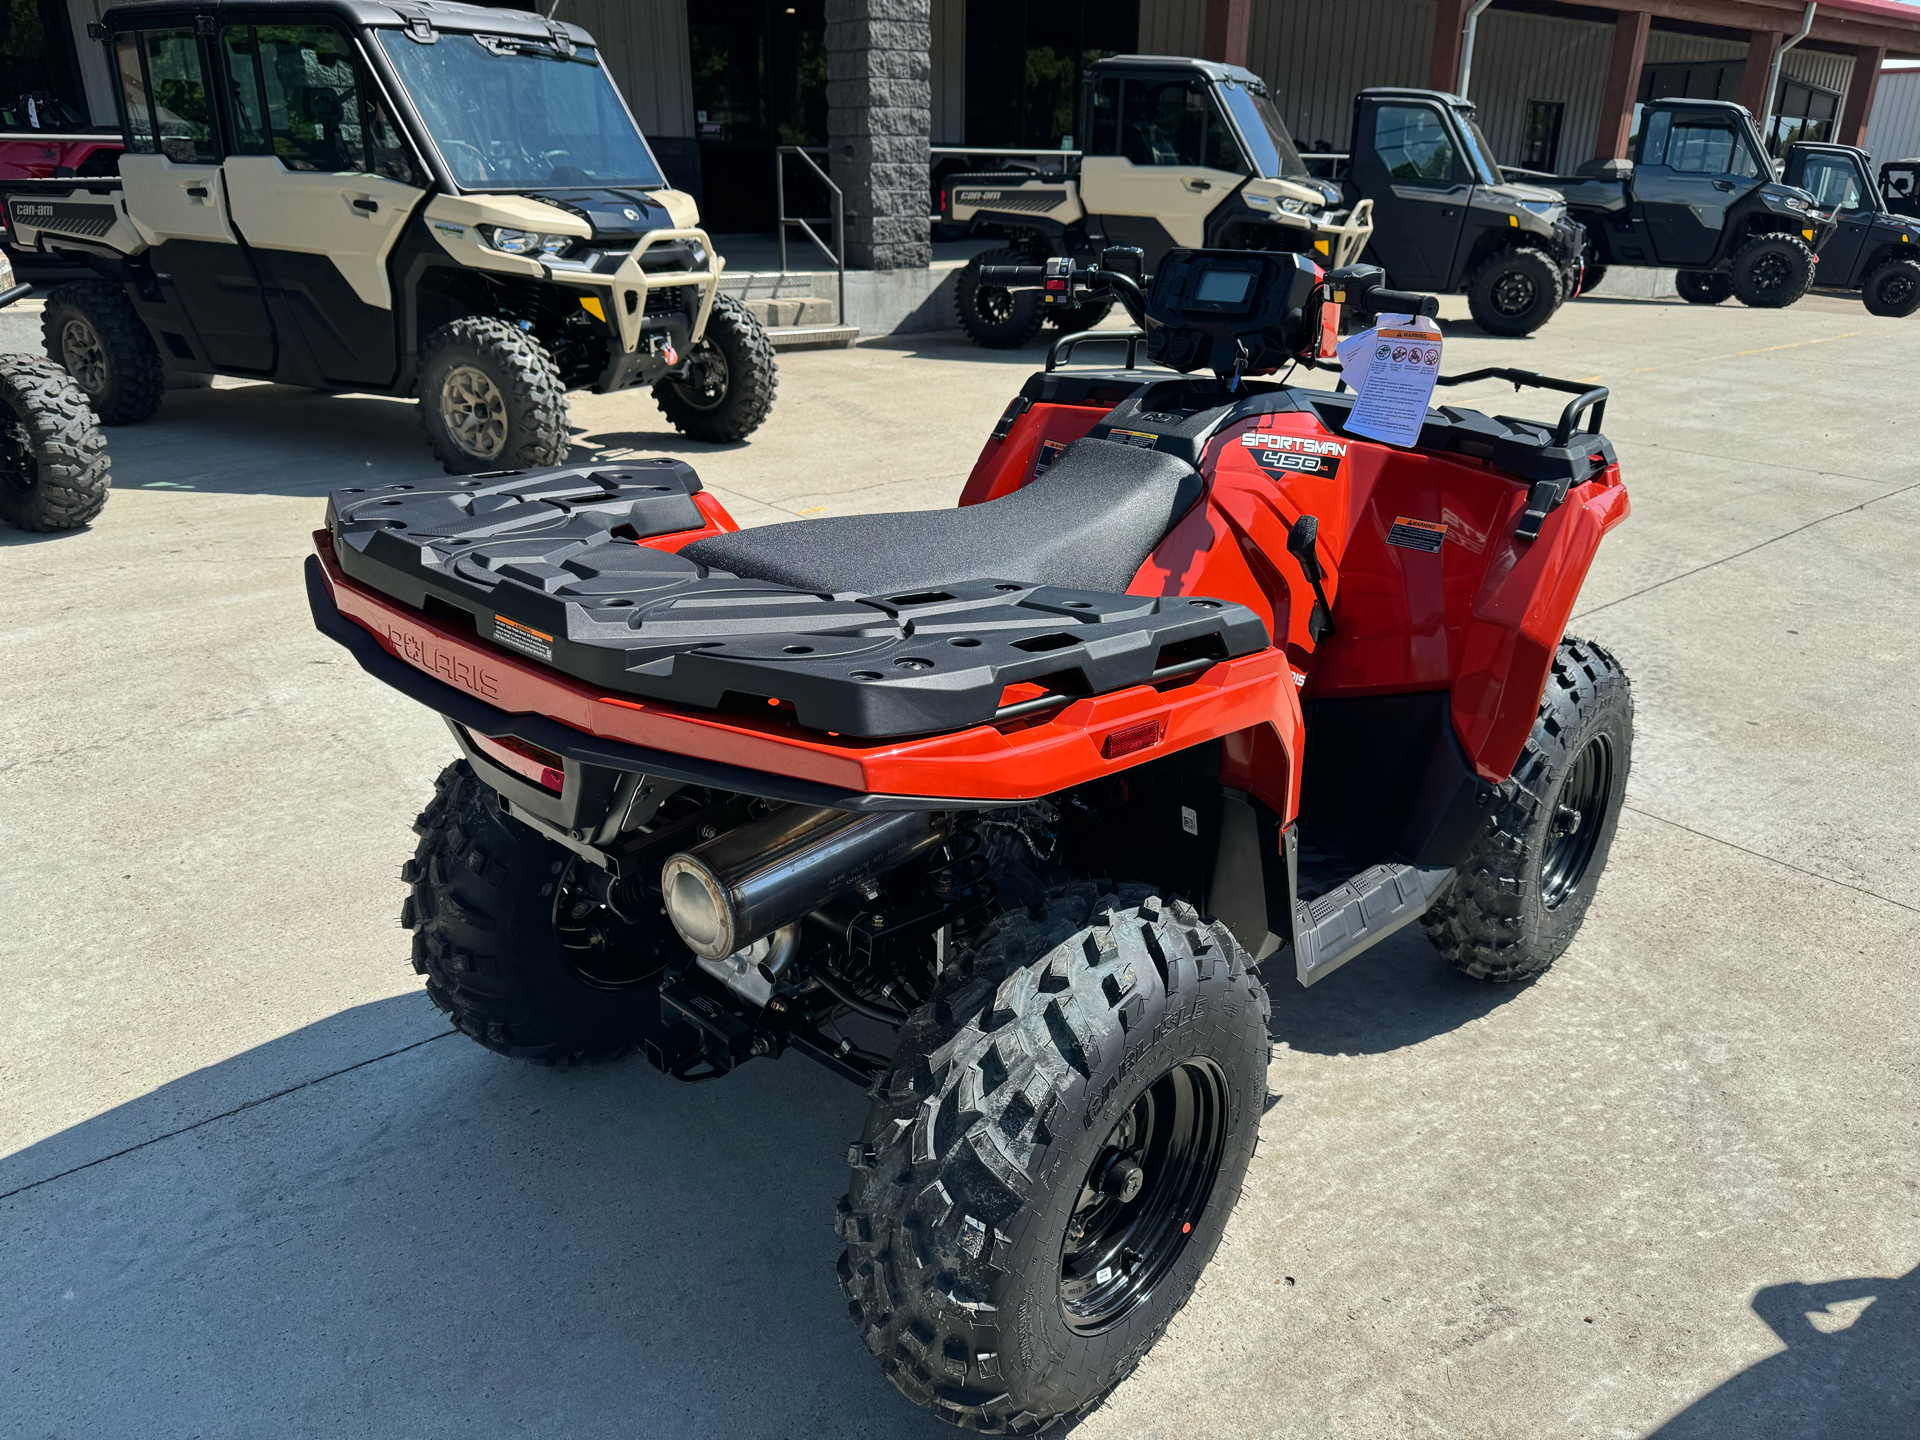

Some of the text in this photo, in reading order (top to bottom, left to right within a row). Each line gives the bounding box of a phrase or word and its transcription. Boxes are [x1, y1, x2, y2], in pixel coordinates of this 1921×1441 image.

[960, 191, 1001, 200] can-am
[16, 204, 53, 216] can-am
[1241, 432, 1347, 457] SPORTSMAN
[1262, 451, 1321, 472] 450
[1412, 520, 1436, 529] WARNING
[388, 624, 499, 700] POLARIS
[1083, 995, 1208, 1130] CARLISLE
